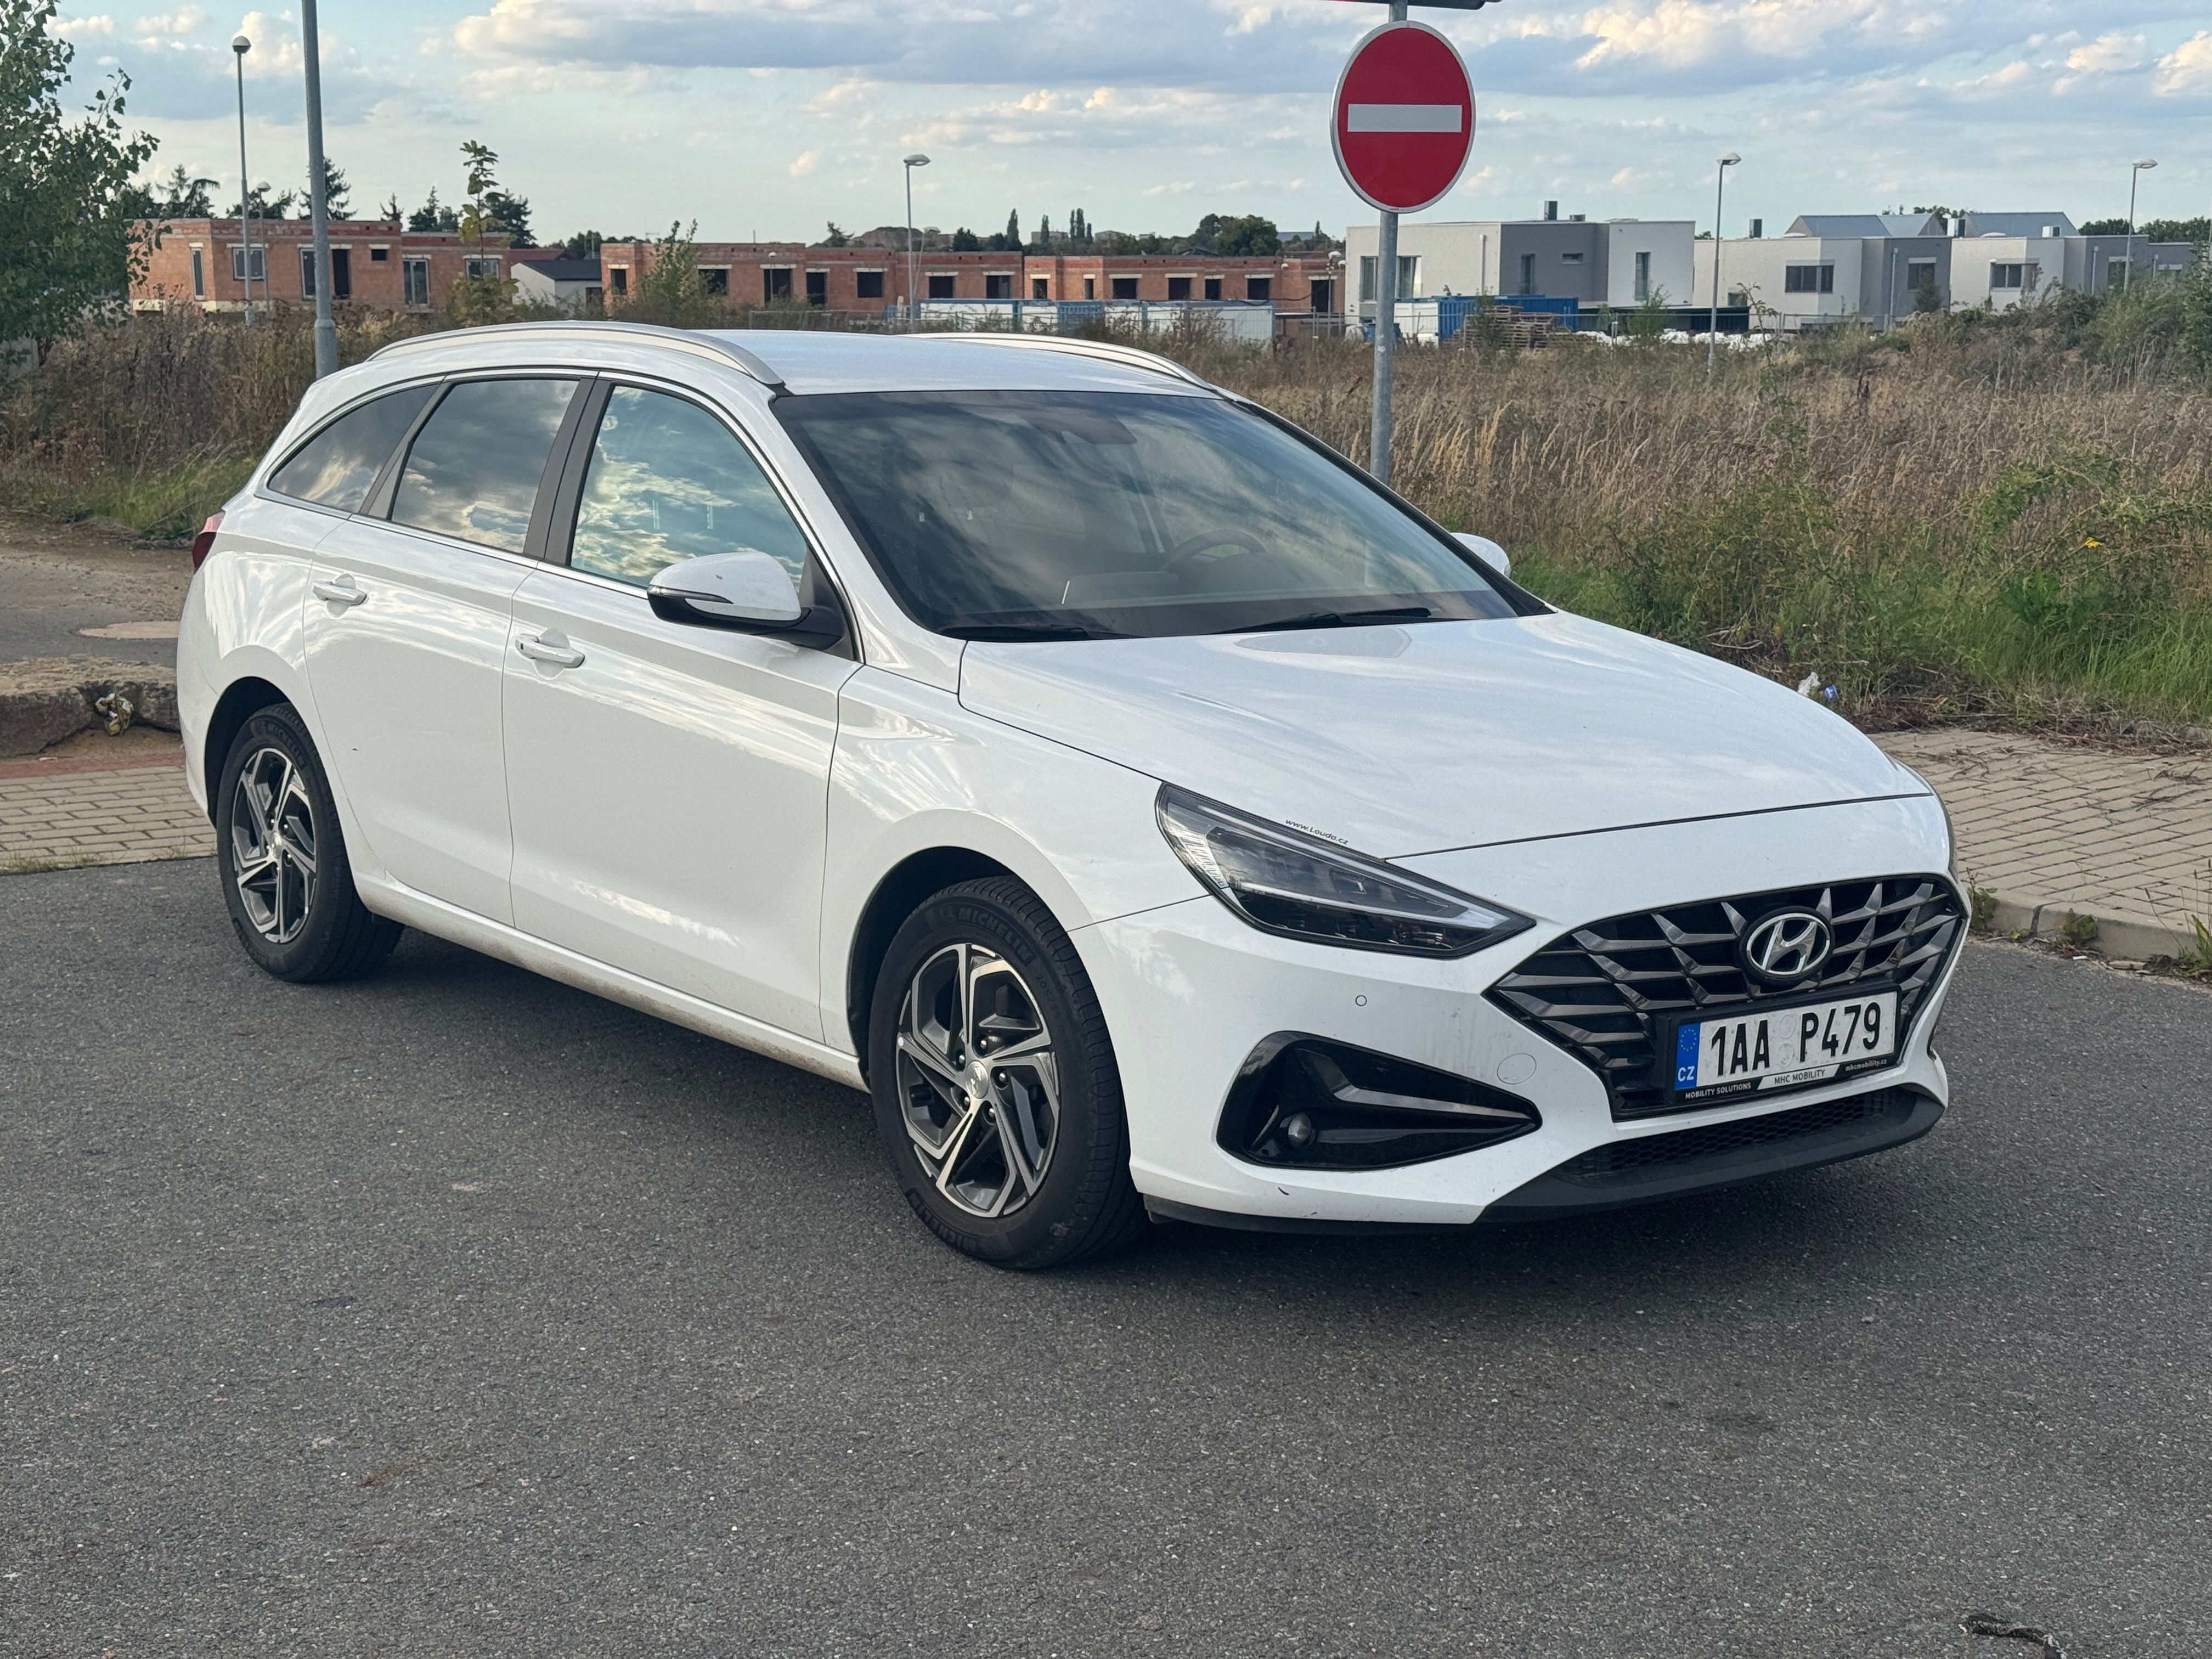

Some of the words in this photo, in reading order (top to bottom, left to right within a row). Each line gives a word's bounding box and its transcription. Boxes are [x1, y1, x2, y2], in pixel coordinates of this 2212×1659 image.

[1285, 819, 1349, 845] www.Louda.cz
[958, 907, 1031, 962] MICHELIN
[1035, 974, 1060, 1019] 205/55
[1711, 1020, 1770, 1076] 1AA
[1799, 1002, 1881, 1063] P479
[1678, 1066, 1695, 1082] CZ
[1845, 1059, 1887, 1071] mhcmobility.cz
[1774, 1075, 1791, 1085] MHC
[1792, 1069, 1825, 1082] MOBILITY
[1685, 1088, 1716, 1099] MOBILITY
[1716, 1082, 1752, 1094] SOLUTIONS
